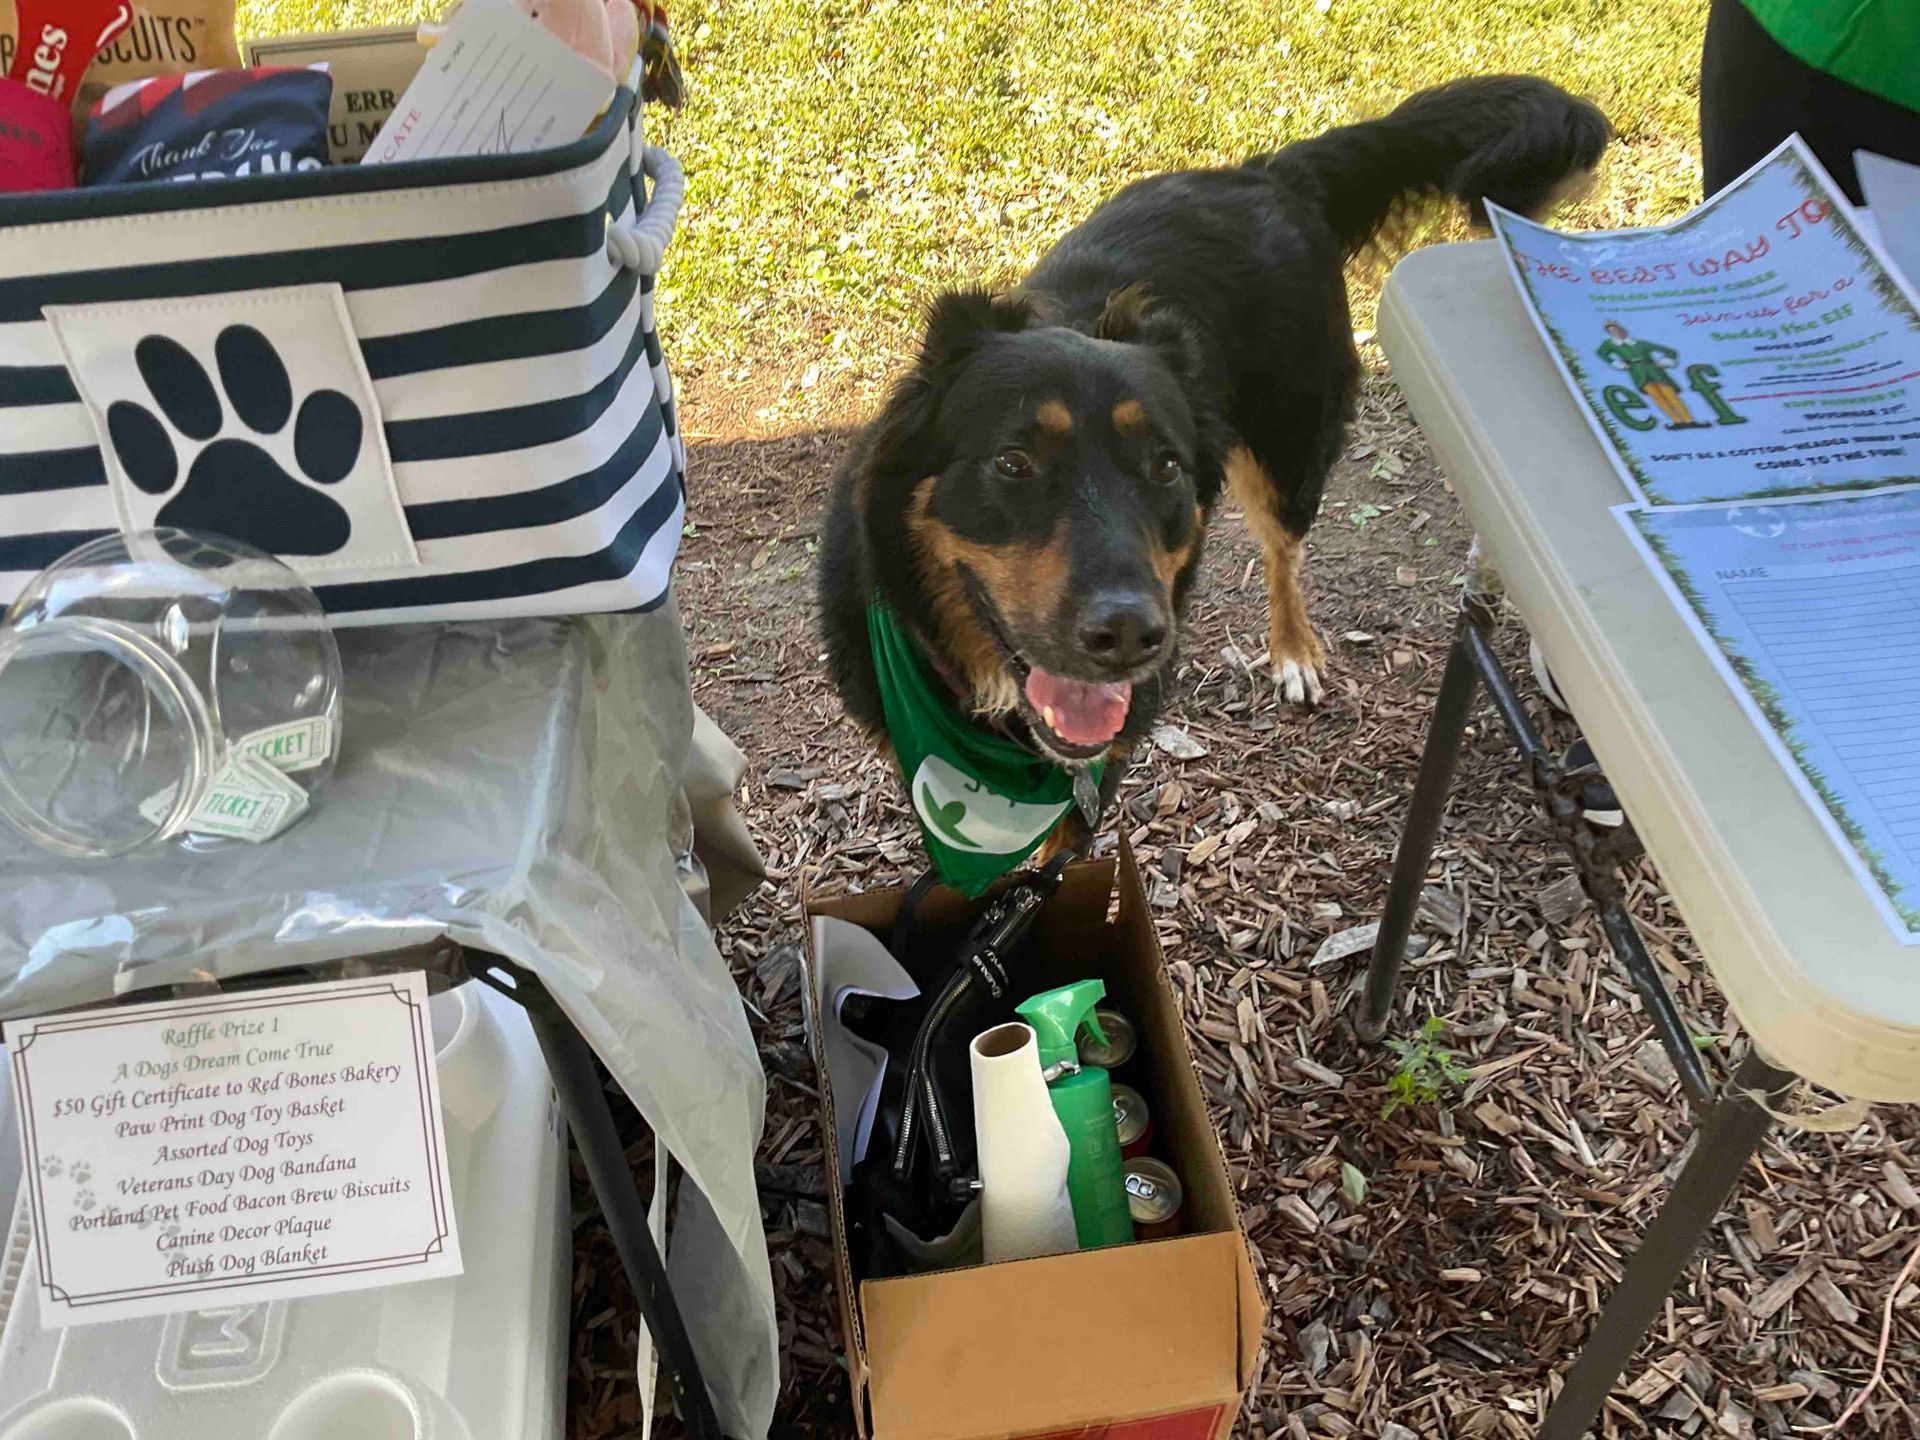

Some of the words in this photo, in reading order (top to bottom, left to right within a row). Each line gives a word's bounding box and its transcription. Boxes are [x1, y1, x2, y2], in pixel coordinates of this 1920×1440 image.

[129, 130, 217, 176] Thank
[382, 107, 422, 162] CATE
[1515, 252, 1582, 283] THE
[1590, 262, 1677, 285] BEST
[1689, 235, 1770, 277] WAY
[1776, 199, 1832, 240] TO
[1784, 290, 1831, 316] for
[1833, 277, 1856, 292] a
[1780, 320, 1819, 335] the
[1755, 459, 1804, 471] COME
[1805, 455, 1832, 466] TO
[1832, 450, 1868, 464] THE
[1714, 566, 1770, 580] NAME
[203, 792, 263, 818] TICKET
[161, 1023, 215, 1048] Raffle
[220, 1022, 265, 1038] Prize
[272, 1017, 278, 1032] 1
[112, 1062, 129, 1083] A
[134, 1060, 178, 1080] Dogs
[183, 1054, 240, 1071] Dream
[246, 1048, 290, 1066] Come
[295, 1041, 333, 1059] True
[53, 1098, 85, 1117] $50
[90, 1090, 125, 1118] Gift
[131, 1083, 220, 1109] Certificate
[226, 1082, 243, 1095] to
[247, 1072, 282, 1095] Red
[285, 1072, 336, 1089] Bones
[340, 1063, 401, 1083] Bakery
[115, 1121, 155, 1138] Paw
[160, 1113, 204, 1132] Print
[209, 1110, 246, 1129] Dog
[250, 1104, 282, 1125] Toy
[287, 1097, 344, 1118] Basket
[153, 1136, 229, 1165] Assorted
[233, 1136, 269, 1155] Dog
[274, 1130, 313, 1152] Toys
[117, 1176, 193, 1195] Veterans
[197, 1169, 235, 1188] Day
[239, 1165, 275, 1184] Dog
[280, 1155, 356, 1176] Bandana
[69, 1204, 146, 1232] Portland
[150, 1205, 179, 1221] Pet
[185, 1194, 230, 1217] Food
[233, 1194, 286, 1211] Bacon
[291, 1188, 337, 1204] Brew
[341, 1177, 410, 1199] Biscuits
[156, 1229, 214, 1251] Canine
[219, 1224, 271, 1242] Decor
[274, 1216, 331, 1238] Plaque
[166, 1255, 214, 1277] Plush
[219, 1254, 255, 1273] Dog
[260, 1244, 328, 1266] Blanket
